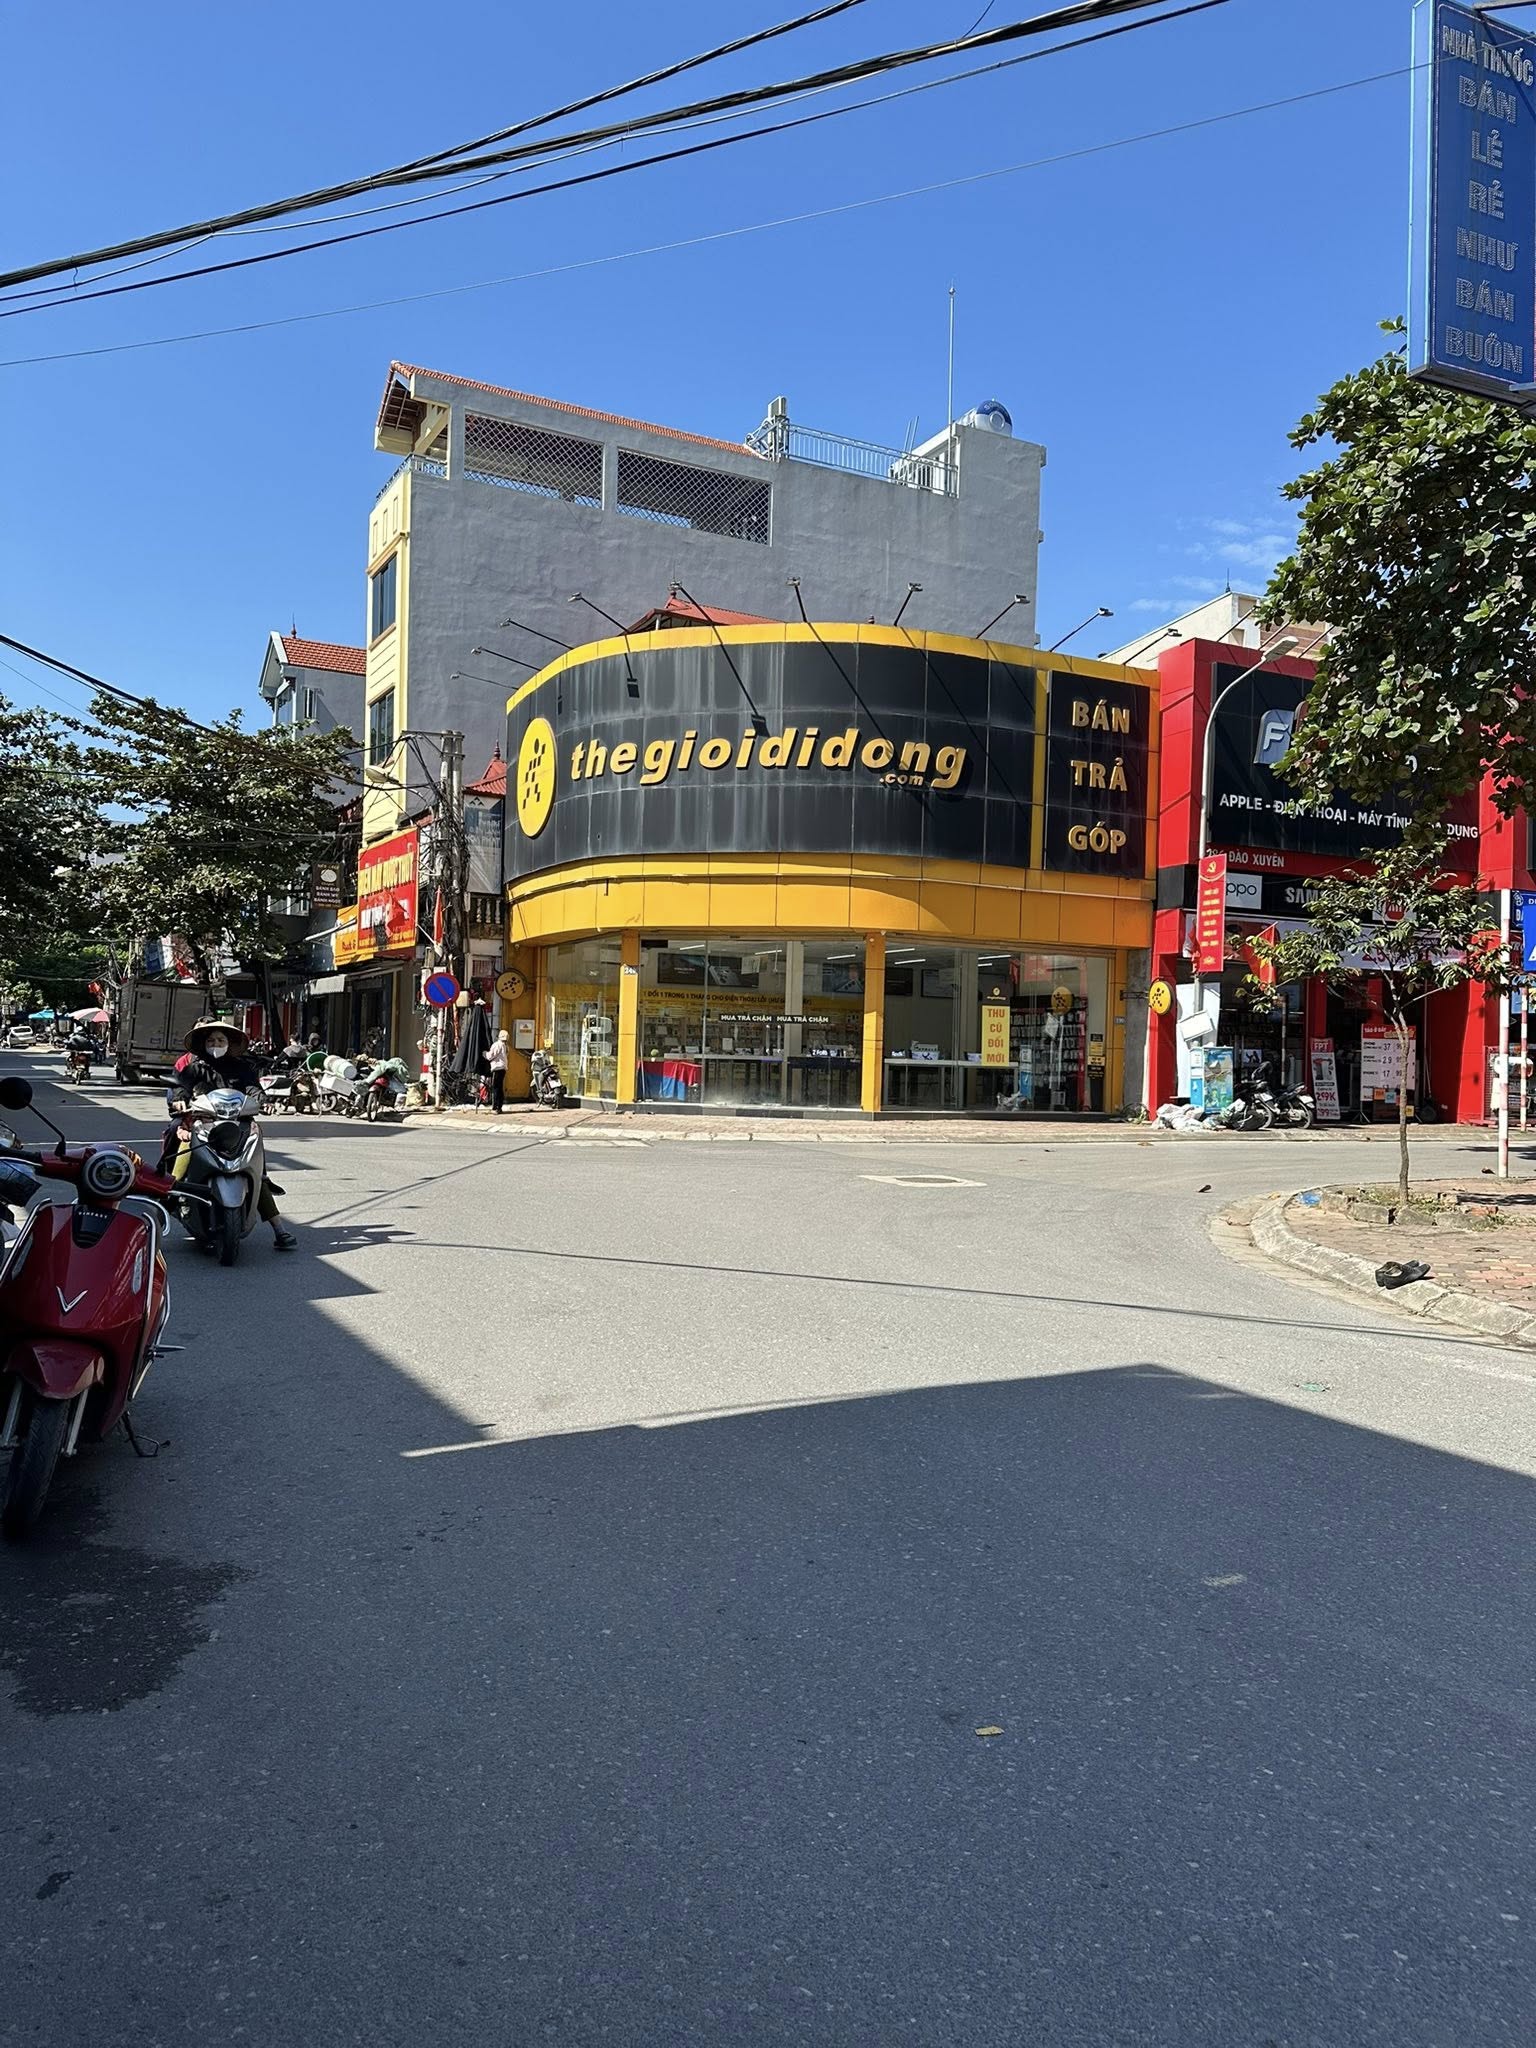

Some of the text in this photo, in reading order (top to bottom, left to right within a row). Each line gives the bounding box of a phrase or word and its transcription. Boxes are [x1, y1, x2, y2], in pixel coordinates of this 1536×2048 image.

[1443, 25, 1534, 86] NHÀ THUỐC
[1459, 75, 1516, 124] BÁN
[1471, 129, 1503, 168] LẺ
[1469, 179, 1504, 219] RẺ
[1456, 226, 1519, 271] NHƯ
[1456, 277, 1514, 322] BÁN
[1445, 325, 1523, 374] BUÔN
[1072, 699, 1130, 733] BÁN
[570, 727, 967, 788] thegioididong
[1070, 757, 1128, 791] TRẢ
[879, 773, 924, 786] .com
[1219, 793, 1263, 811] APPLE
[1358, 810, 1384, 827] MÁY
[1068, 821, 1127, 854] GÓP
[1228, 848, 1249, 864] ĐÀO
[1252, 851, 1285, 867] XUYÊN
[1226, 881, 1258, 897] ppo
[987, 1008, 1005, 1018] THU
[1314, 1043, 1329, 1051] FPT
